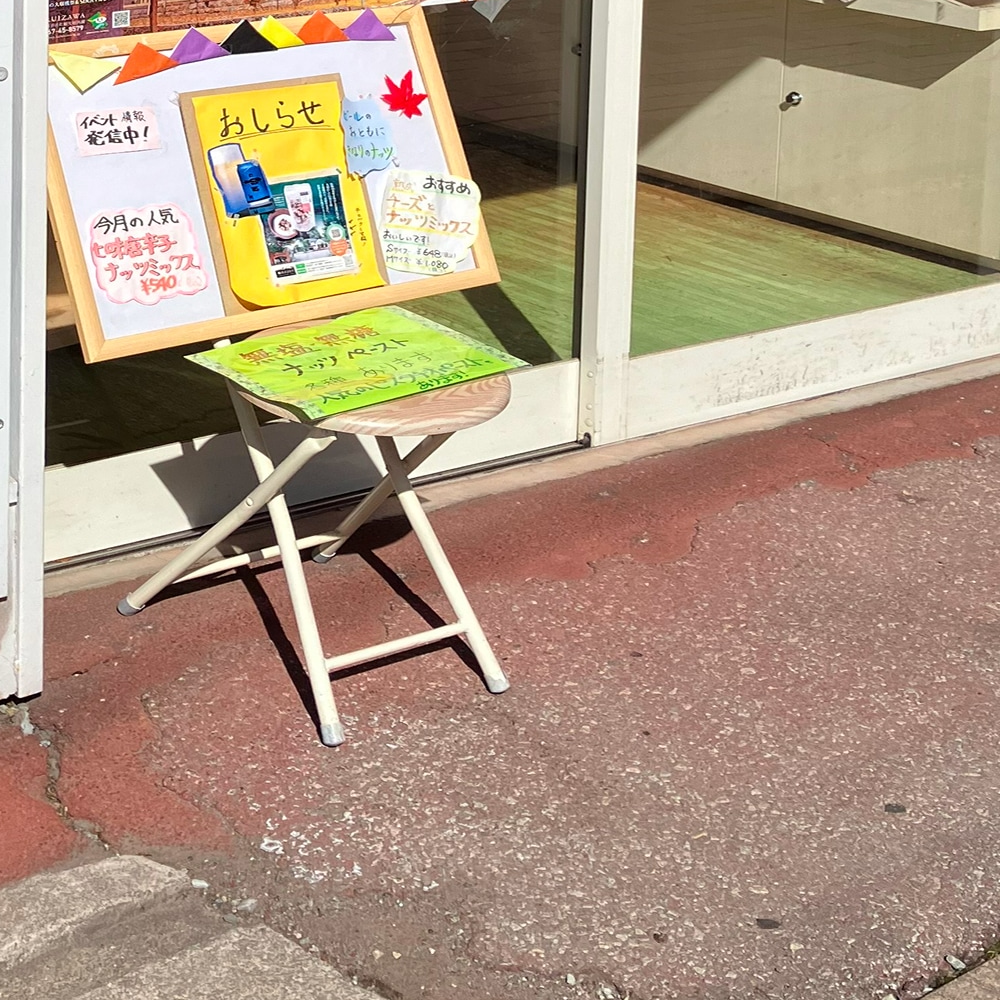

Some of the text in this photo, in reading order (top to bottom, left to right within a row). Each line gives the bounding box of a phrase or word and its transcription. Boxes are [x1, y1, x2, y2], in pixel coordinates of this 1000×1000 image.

[220, 101, 325, 137] おしらせ
[84, 125, 150, 146] 発信中!
[422, 175, 472, 195] おすすめ
[386, 193, 436, 211] チーズと
[93, 208, 180, 234] 今月の人気
[386, 210, 475, 236] ナッツミックス
[93, 233, 178, 261] 七味唐辛子
[104, 254, 202, 283] ナッツミックス
[140, 275, 177, 296] ¥540
